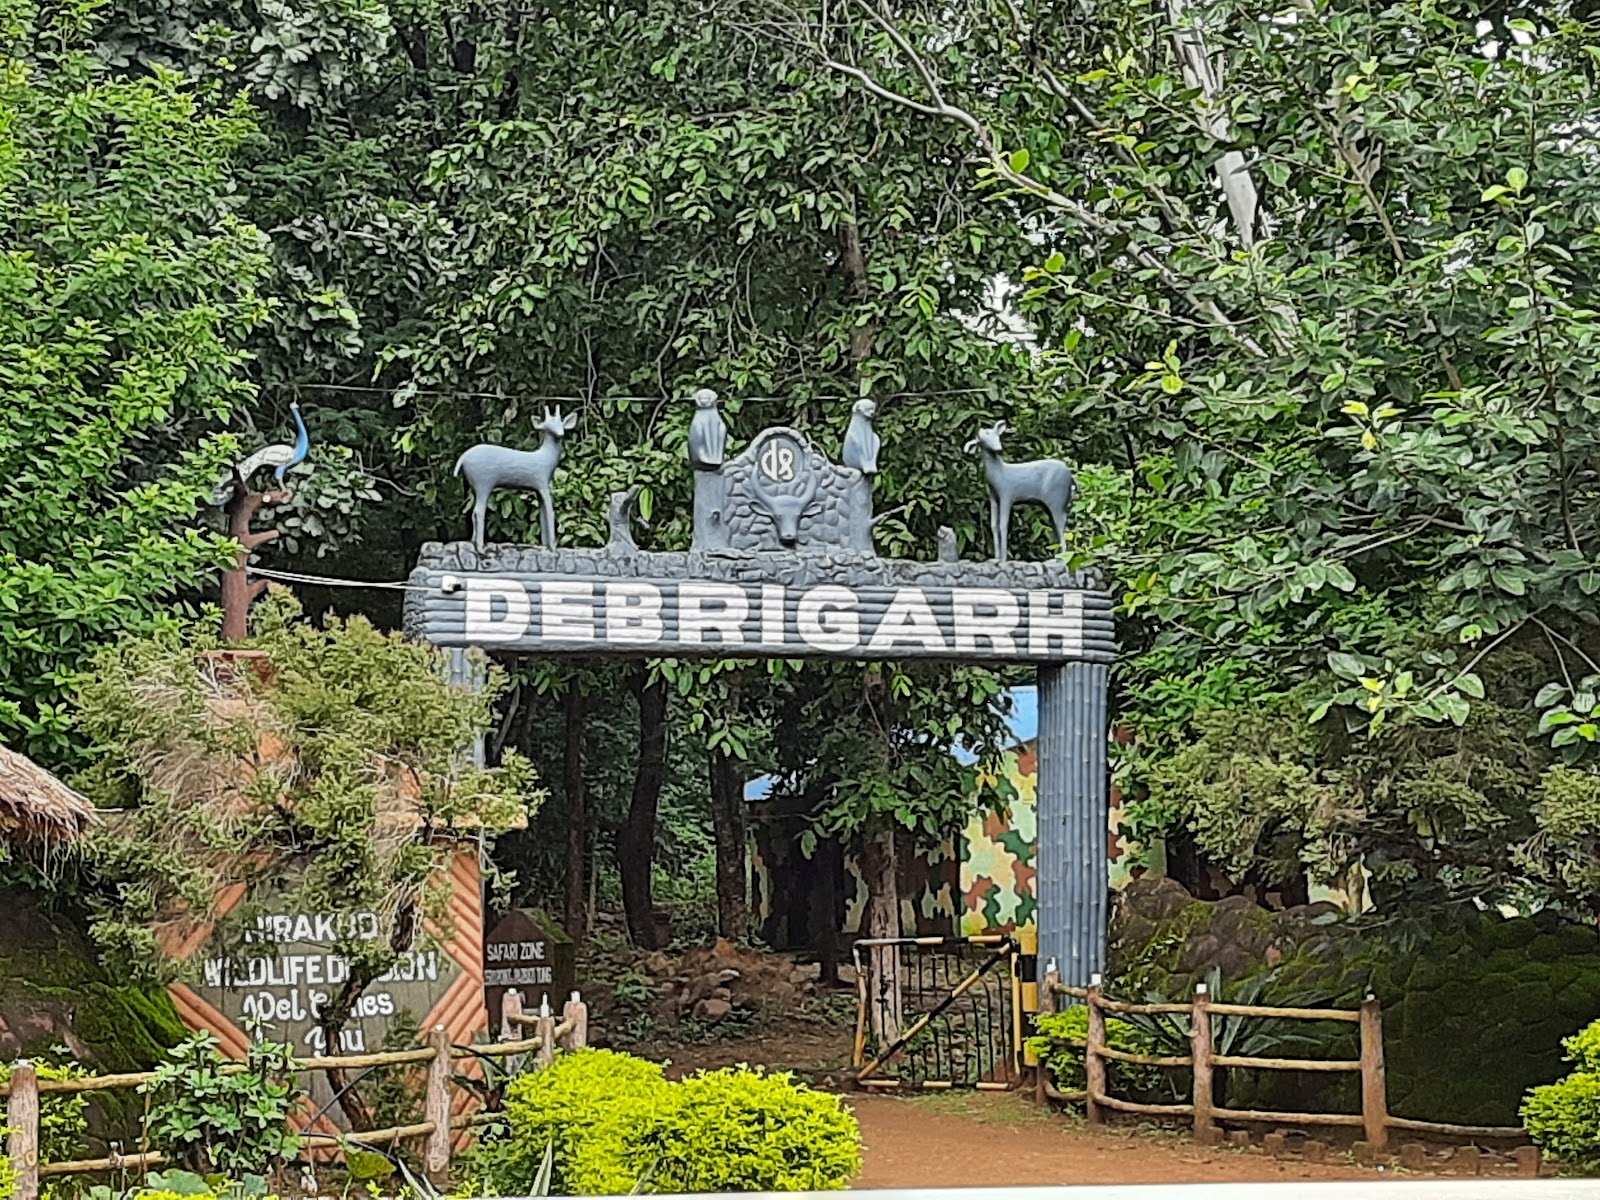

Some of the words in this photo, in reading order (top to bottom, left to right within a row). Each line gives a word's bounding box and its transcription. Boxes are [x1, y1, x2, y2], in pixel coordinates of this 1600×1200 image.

[464, 576, 1084, 658] DEBRIGARH
[327, 951, 440, 984] DIION
[486, 942, 519, 962] SAFARI
[519, 941, 545, 960] ZONE
[308, 989, 394, 1019] Ces
[304, 1026, 366, 1058] Yu
